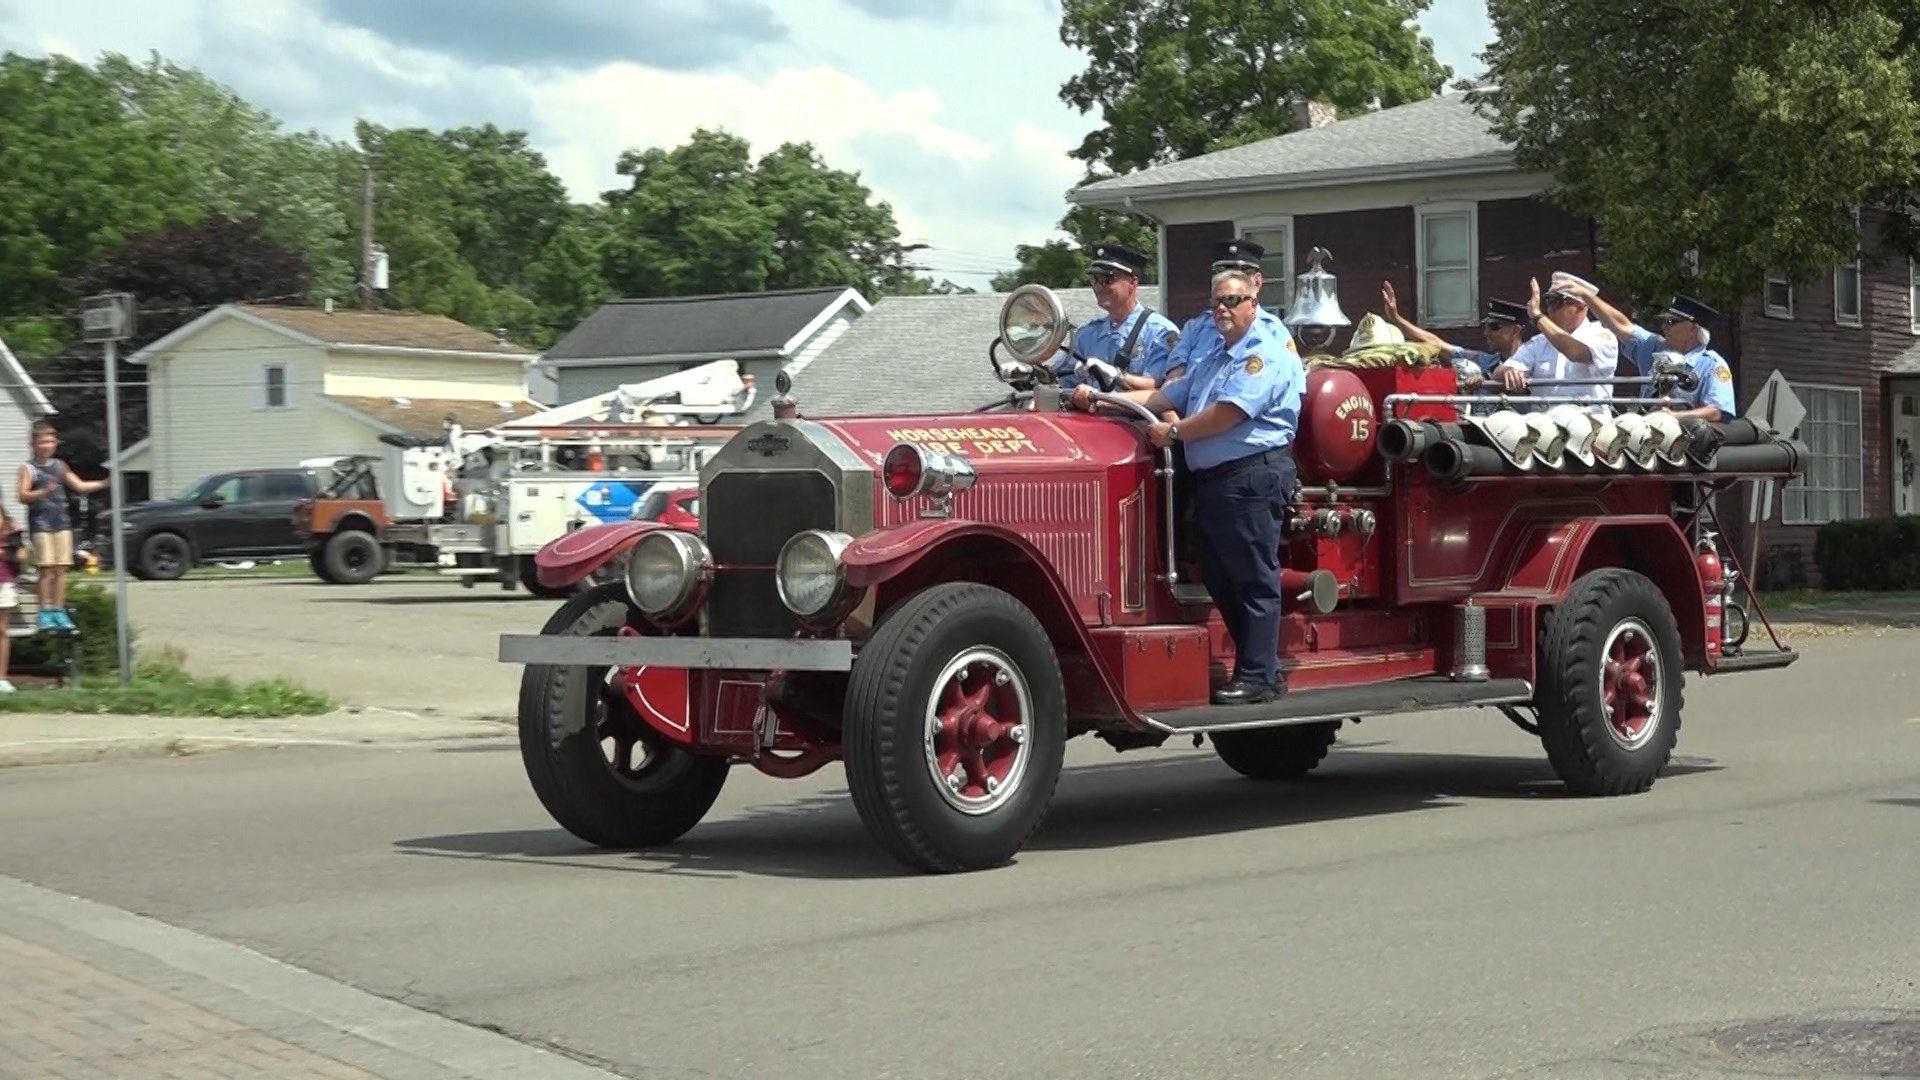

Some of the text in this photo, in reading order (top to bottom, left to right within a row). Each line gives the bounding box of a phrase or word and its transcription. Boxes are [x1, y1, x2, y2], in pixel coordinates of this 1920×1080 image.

[886, 427, 1025, 441] HORSEHEADS
[1351, 419, 1369, 441] 15
[918, 440, 1045, 456] IRE DEPT.
